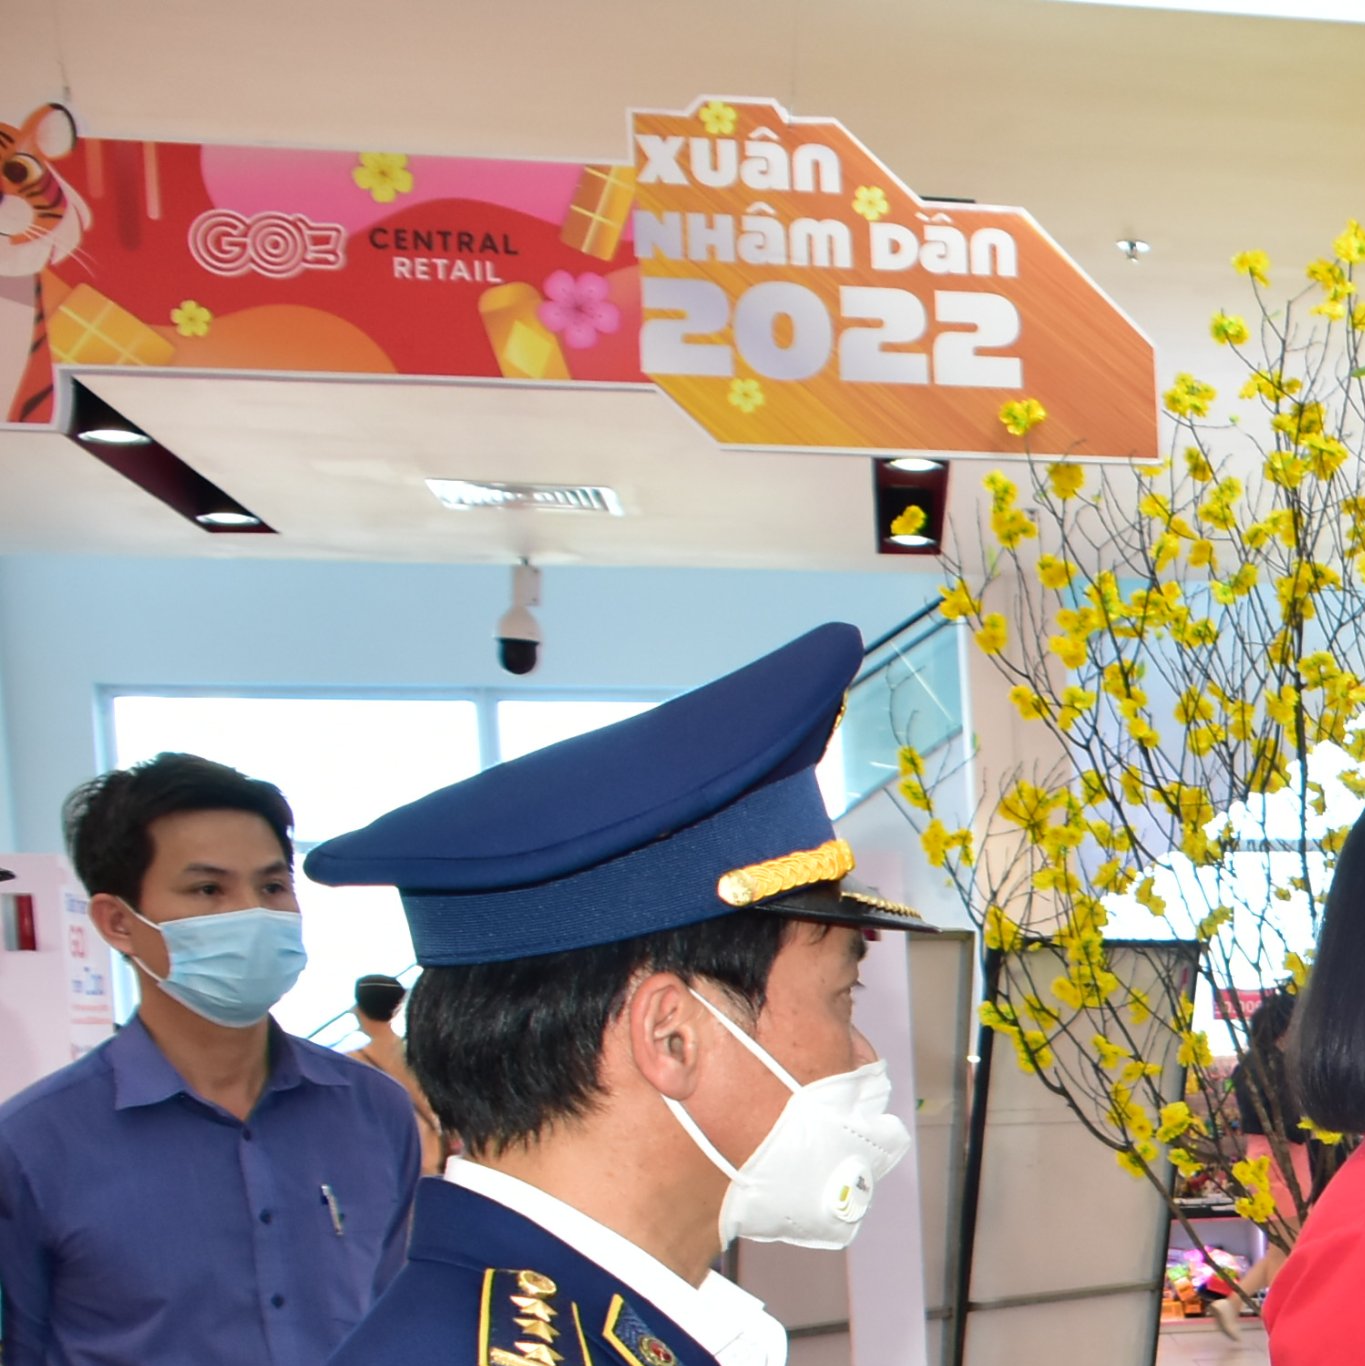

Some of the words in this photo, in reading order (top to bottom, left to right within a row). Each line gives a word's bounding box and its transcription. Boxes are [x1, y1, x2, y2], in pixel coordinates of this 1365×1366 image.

[369, 227, 518, 256] CENTRAL
[392, 256, 503, 284] RETAIL
[640, 276, 1024, 389] 2022
